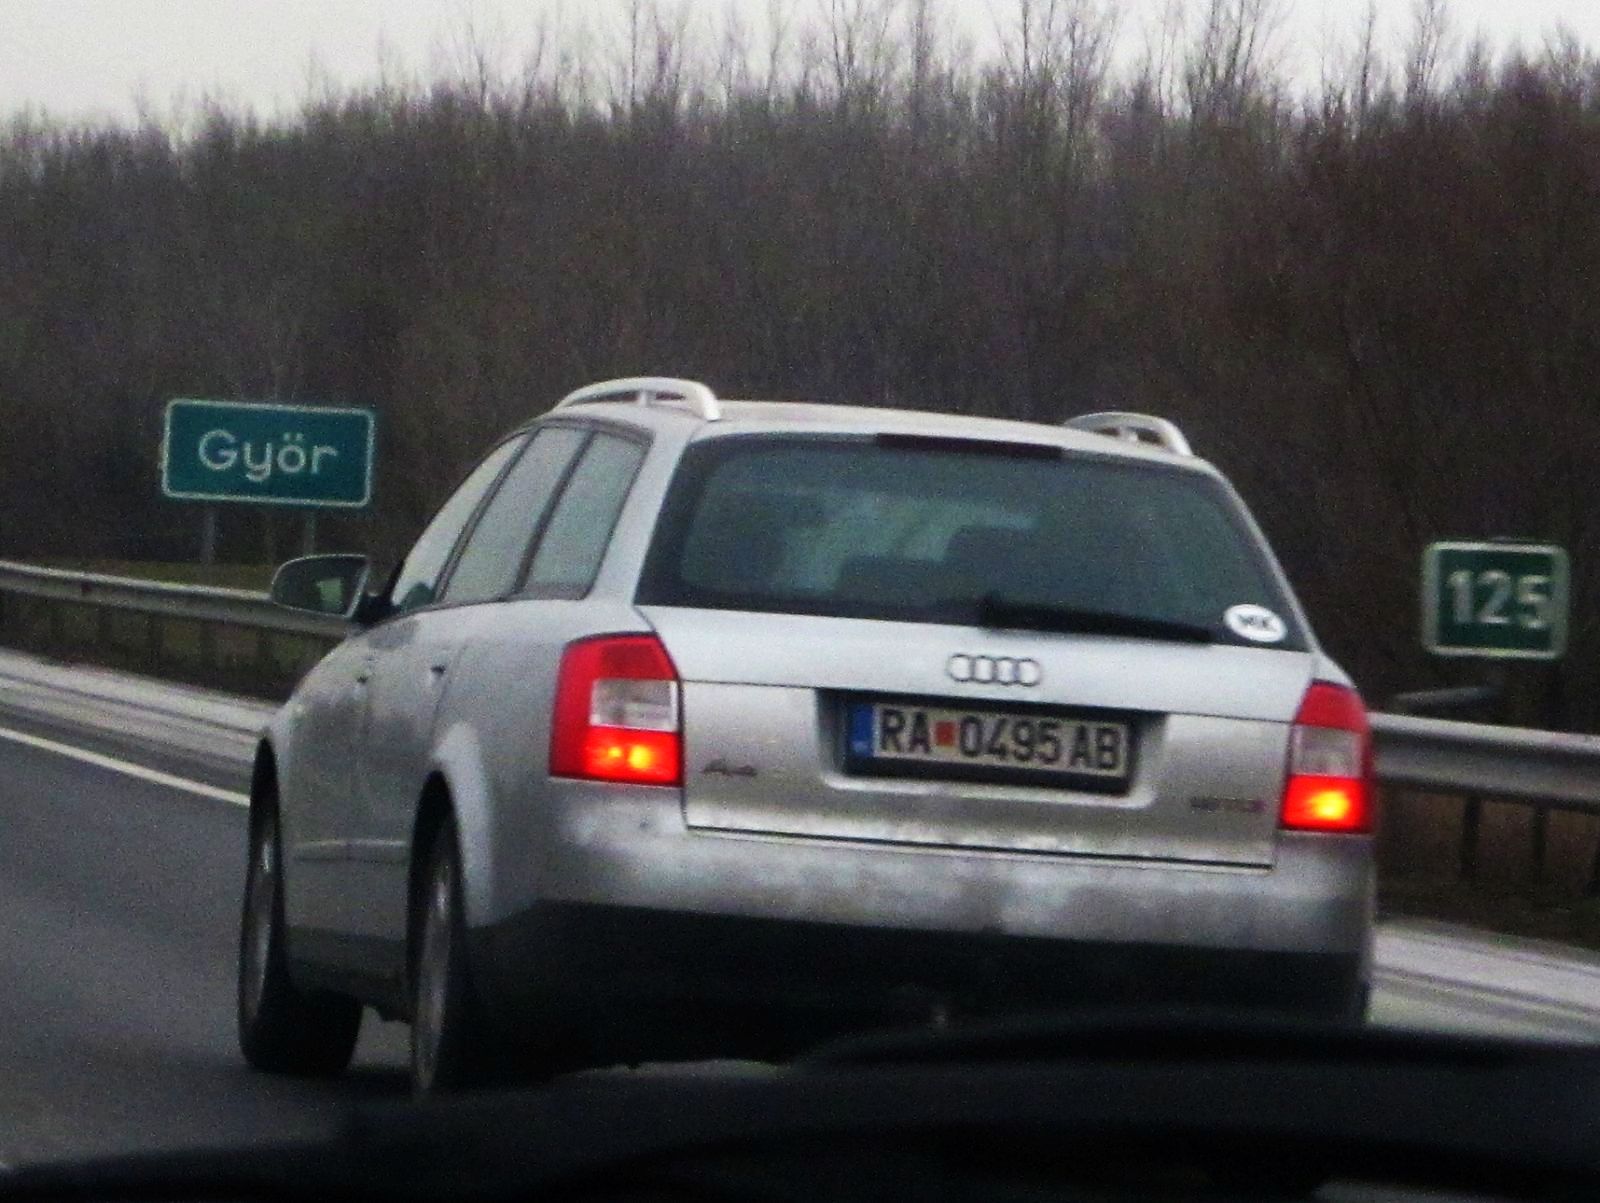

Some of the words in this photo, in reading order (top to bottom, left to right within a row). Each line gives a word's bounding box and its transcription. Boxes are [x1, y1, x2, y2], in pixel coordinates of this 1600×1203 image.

[1448, 569, 1552, 630] 125
[880, 708, 930, 753] RA
[959, 715, 1061, 765] 0495
[1069, 725, 1121, 770] AB
